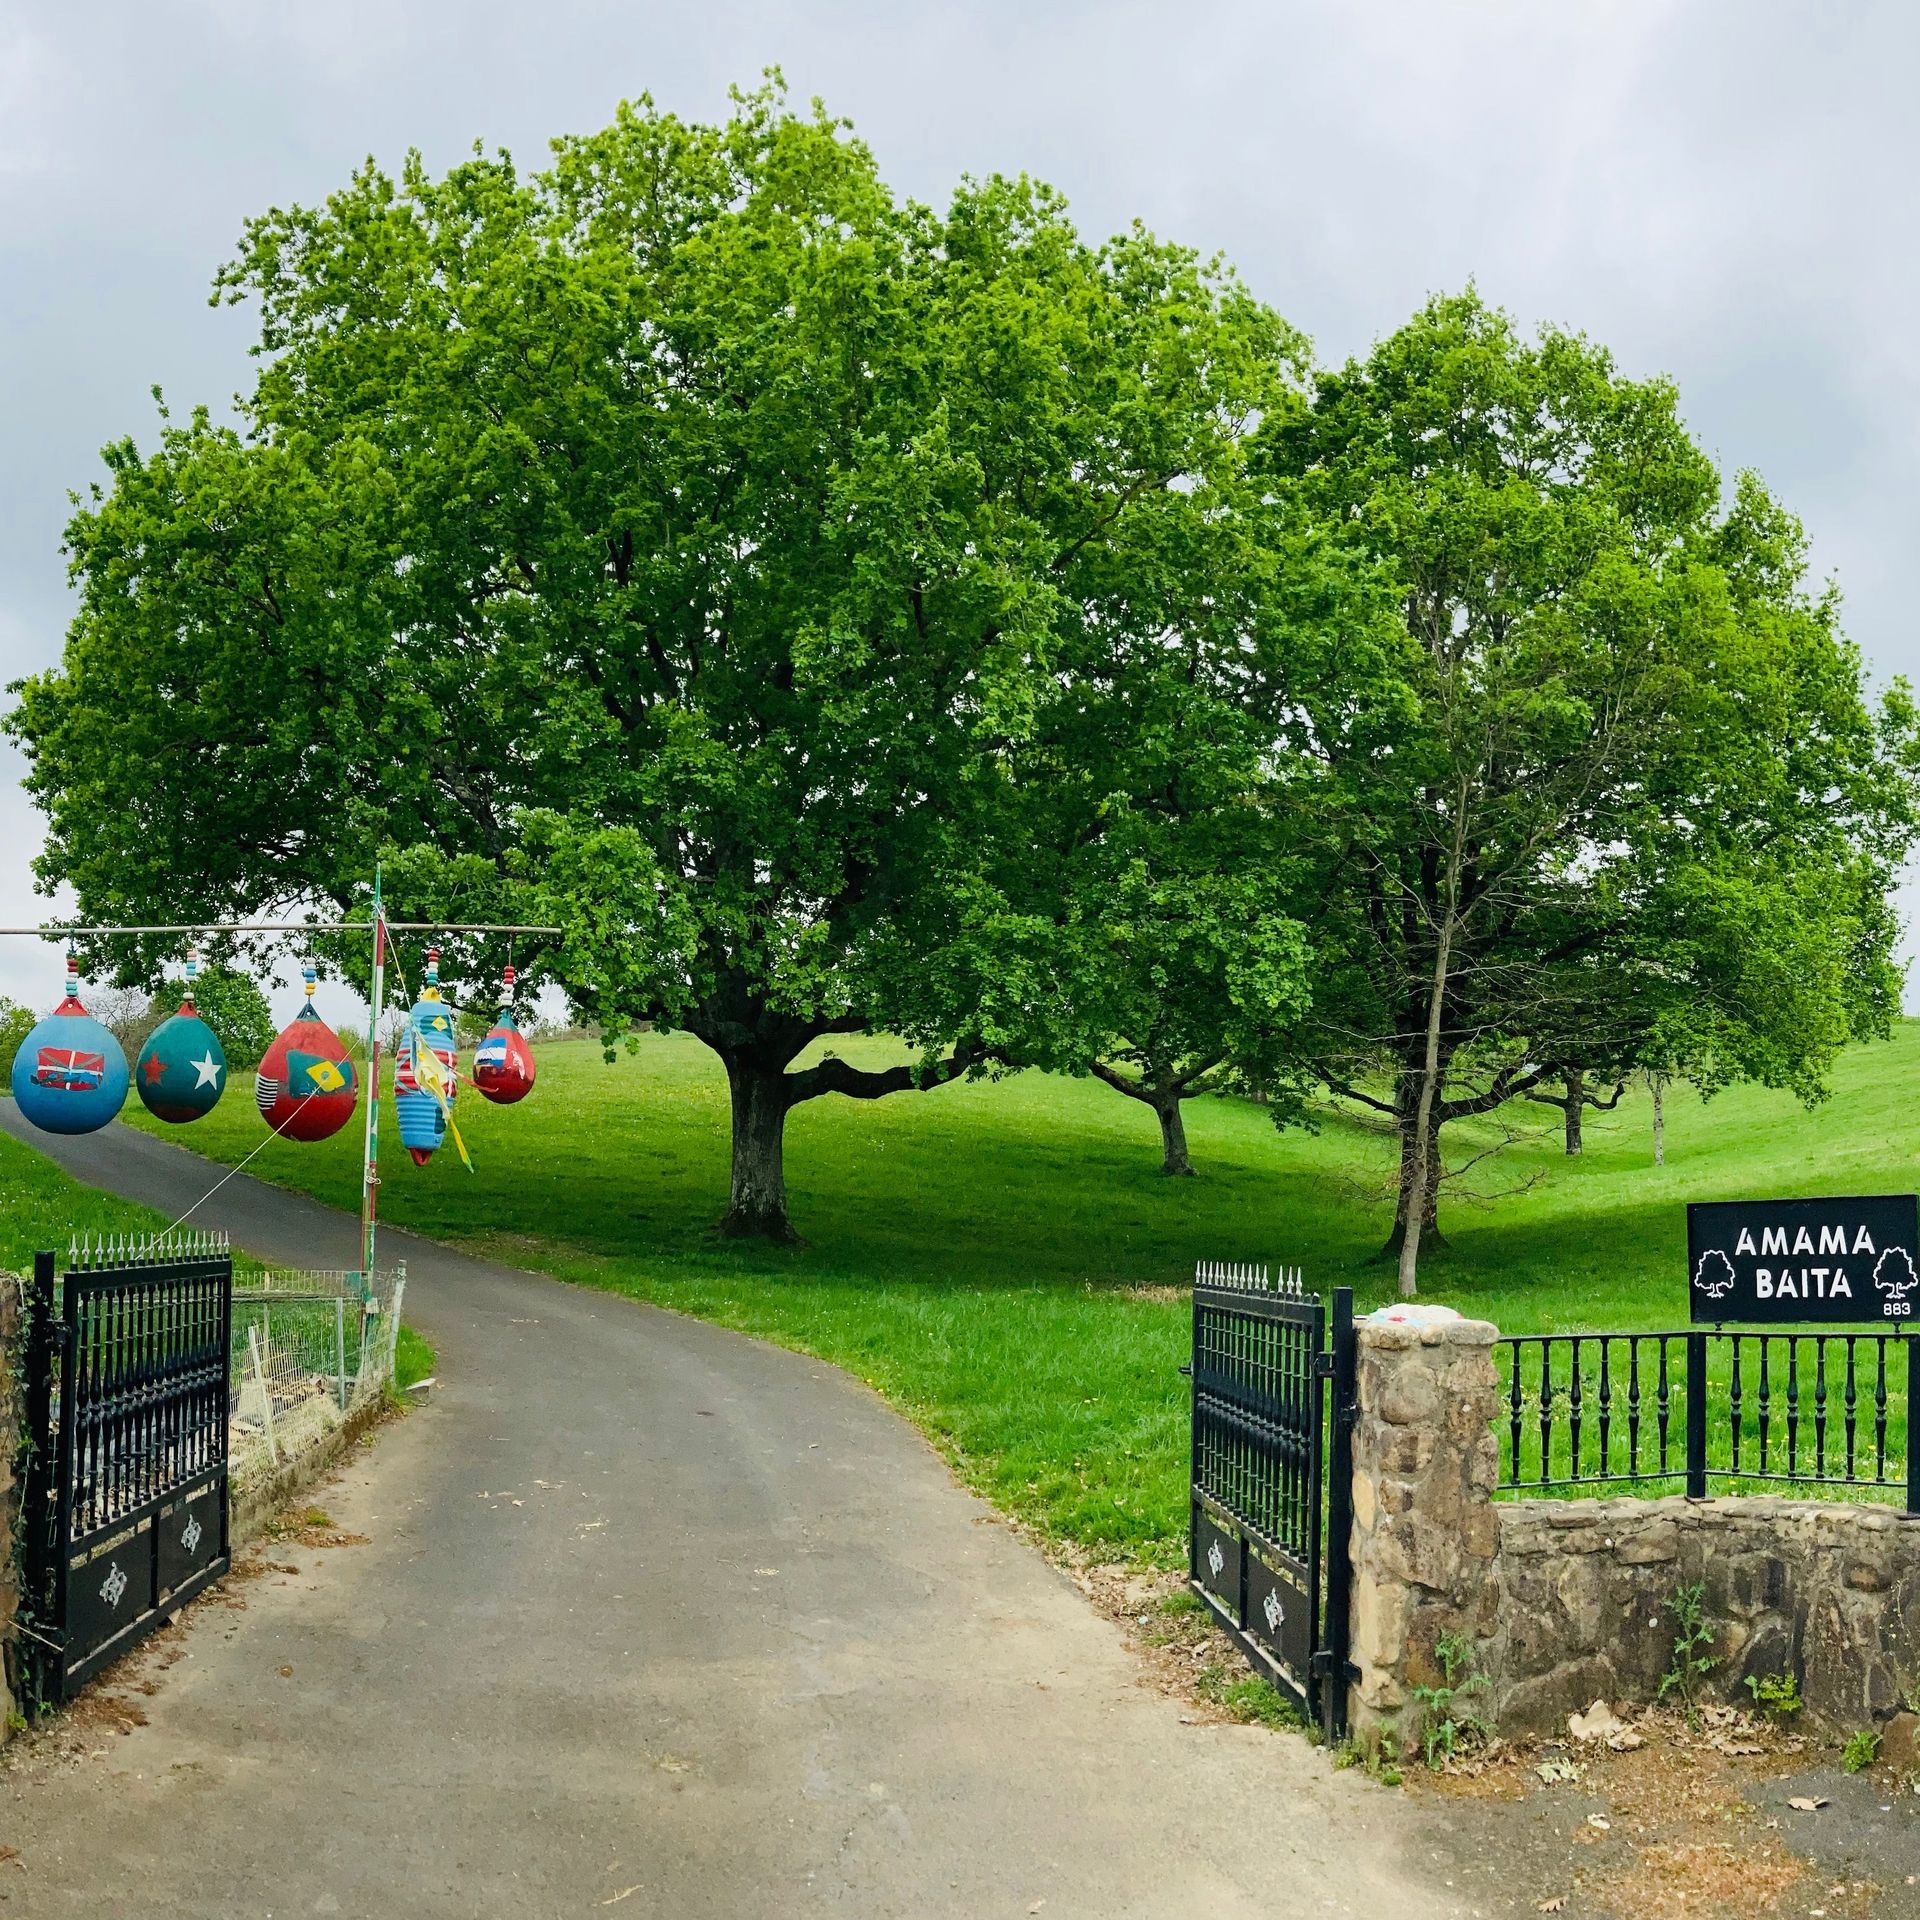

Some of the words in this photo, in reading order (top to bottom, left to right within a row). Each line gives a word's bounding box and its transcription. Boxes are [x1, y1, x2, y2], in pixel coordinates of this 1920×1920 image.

[1734, 1225, 1876, 1256] AMAMA
[1756, 1268, 1853, 1299] BAITA
[1883, 1302, 1911, 1316] 883
